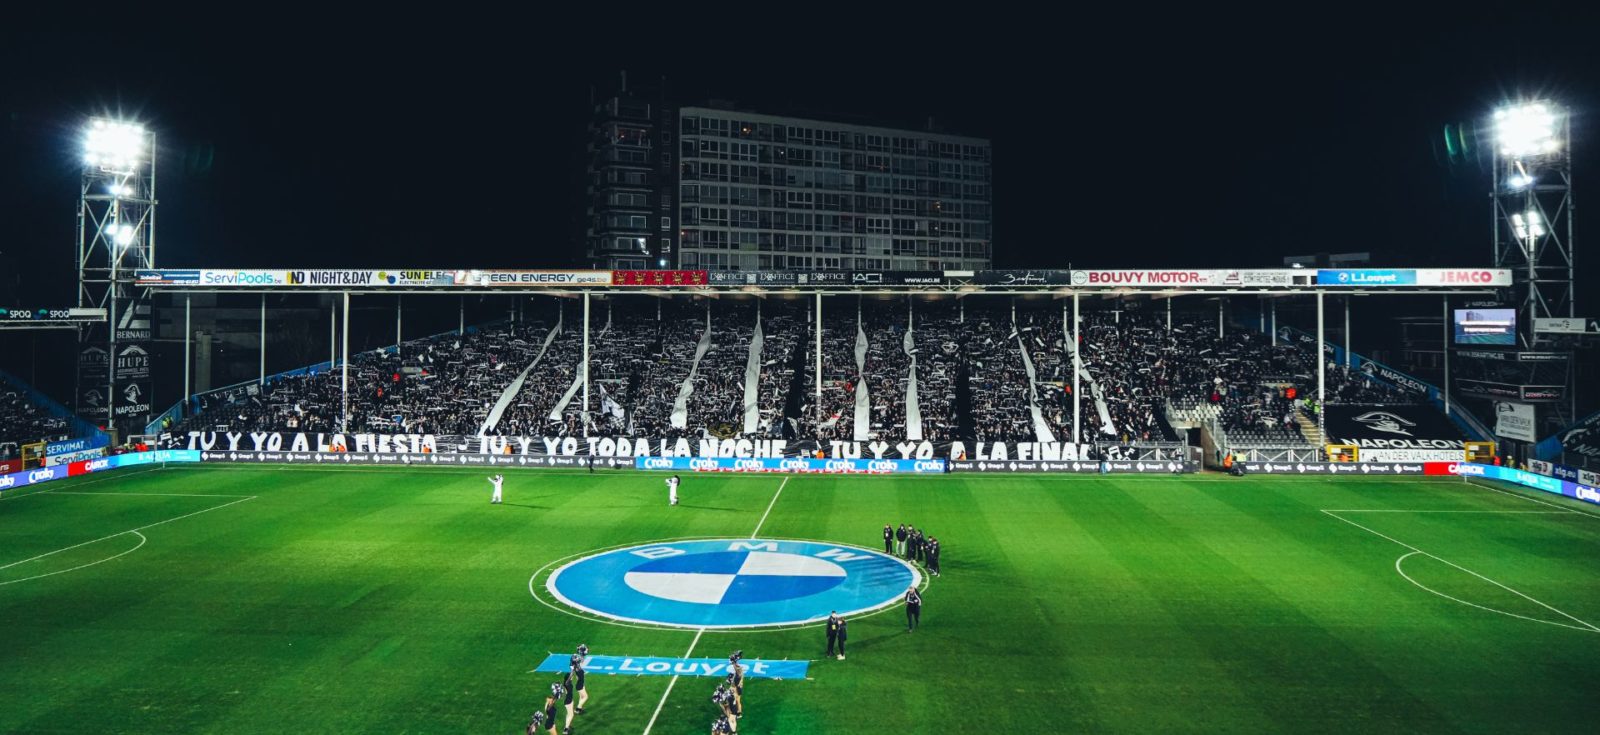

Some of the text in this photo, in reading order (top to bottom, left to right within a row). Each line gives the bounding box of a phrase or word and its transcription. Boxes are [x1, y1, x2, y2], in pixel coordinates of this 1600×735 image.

[290, 272, 373, 284] ND NIGHT&DAY
[399, 271, 421, 280] SUN
[521, 274, 575, 283] ENERGY
[1089, 272, 1199, 283] BOUVY MOTOR
[1351, 273, 1396, 284] L.Louyet
[1440, 271, 1492, 283] JEMCO
[9, 310, 31, 318] SPOQ
[49, 310, 69, 318] SPOQ
[116, 331, 151, 339] BERNARD
[117, 356, 149, 368] HUPE
[1380, 369, 1427, 393] NAPOLEON
[115, 403, 149, 415] NAPOLEON
[46, 441, 84, 455] SERVIMAT
[188, 431, 437, 454] TU Y YO A LA FIESTA
[480, 435, 787, 458] TU Y YO TODA LA NOCHE
[1341, 438, 1465, 449] NAPOLEON
[830, 440, 1090, 461] TU Y YO A LA FINAL
[644, 458, 673, 469] Croky
[689, 458, 718, 469] Croky
[734, 458, 763, 469] Croky
[780, 458, 809, 470] Croky
[825, 459, 855, 470] Croky
[868, 459, 898, 470] Croky
[914, 460, 944, 471] Croky
[28, 468, 54, 483] Croky
[582, 656, 770, 677] L.Louyet
